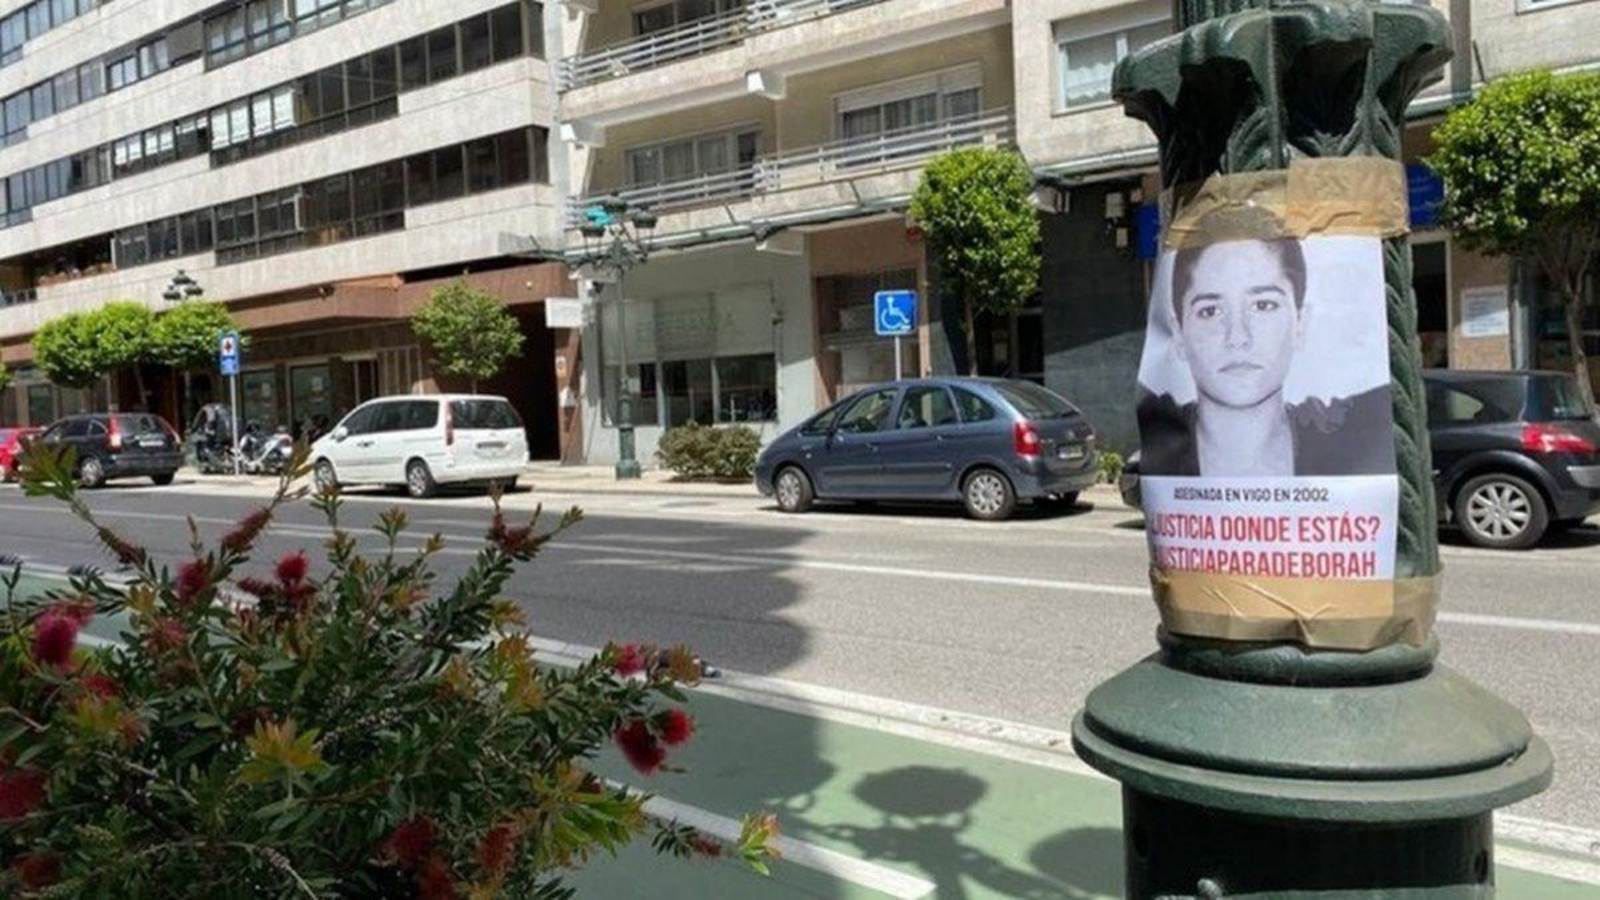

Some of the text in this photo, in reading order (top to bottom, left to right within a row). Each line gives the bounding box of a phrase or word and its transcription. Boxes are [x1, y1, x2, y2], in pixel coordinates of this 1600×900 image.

[1225, 488, 1241, 502] EN
[1243, 488, 1271, 502] VIGO
[1274, 488, 1290, 502] EN
[1293, 488, 1329, 502] 2002
[1220, 515, 1291, 542] DONDE
[1298, 511, 1381, 542] ESTÁS?
